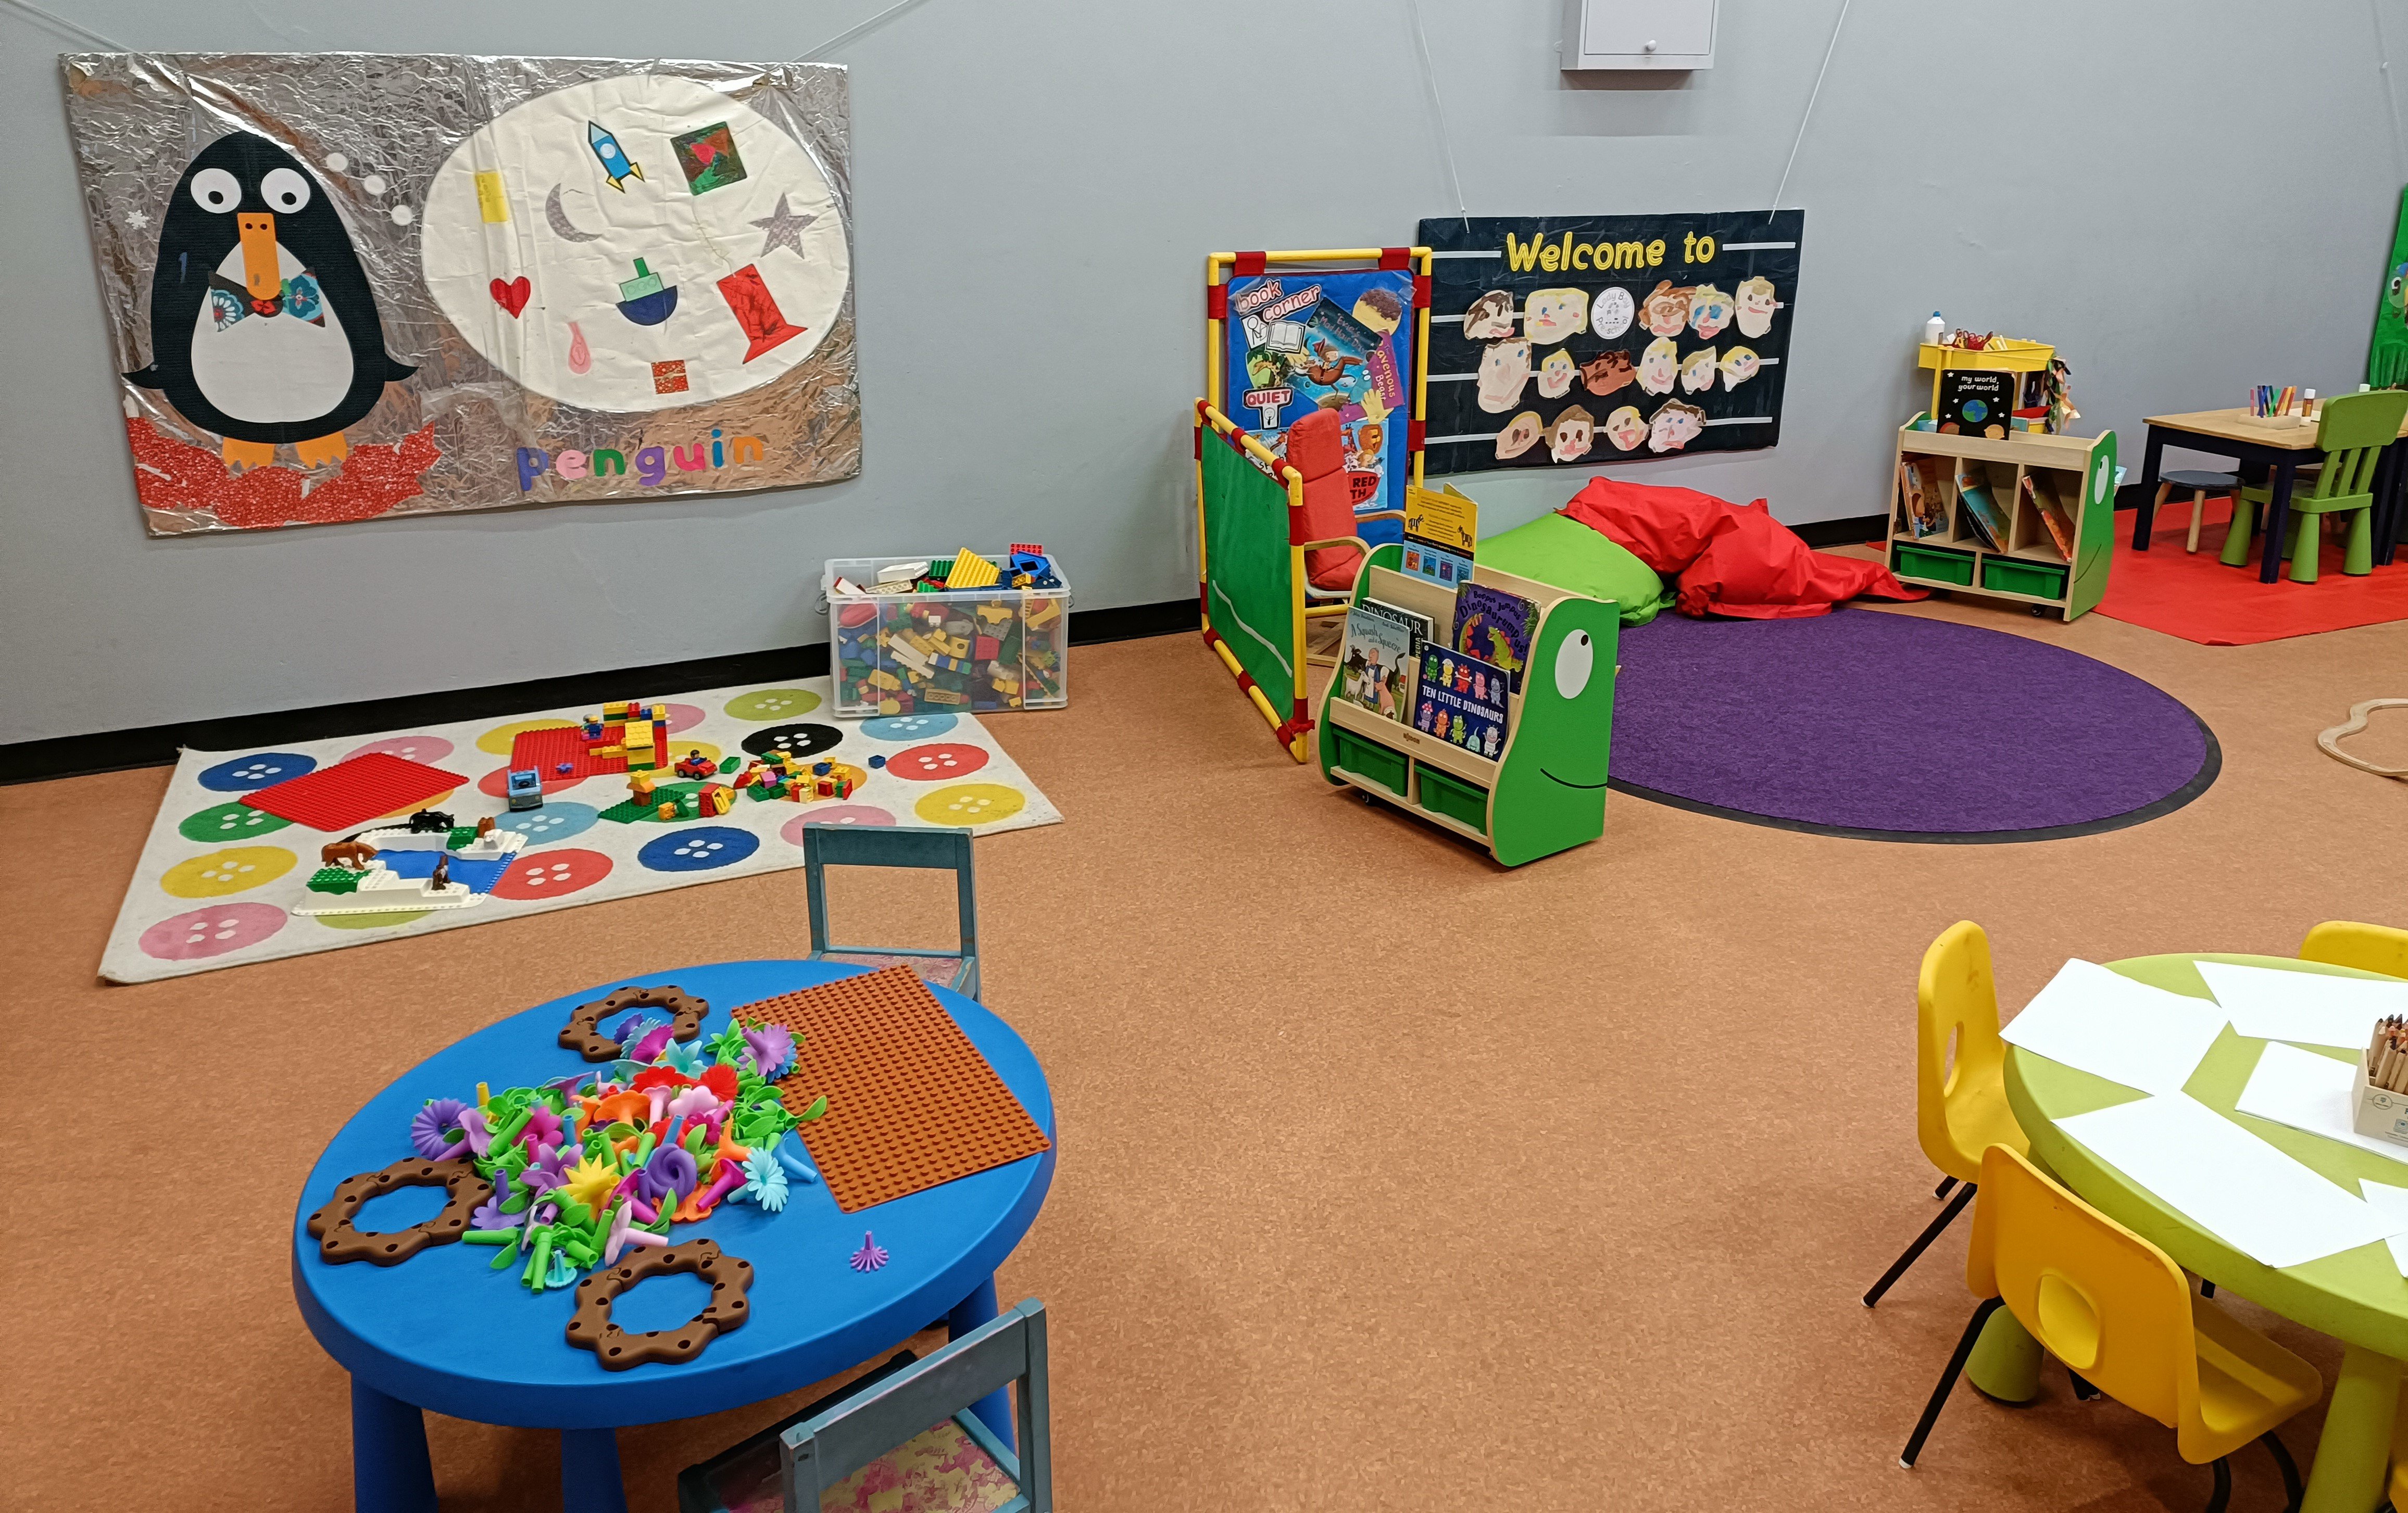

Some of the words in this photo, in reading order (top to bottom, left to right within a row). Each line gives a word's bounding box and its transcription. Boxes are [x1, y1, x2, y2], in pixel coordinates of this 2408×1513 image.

[1507, 231, 1665, 272] Welcome
[1684, 231, 1715, 263] to
[1237, 280, 1282, 311] book
[1264, 286, 1319, 321] corner
[1597, 292, 1616, 308] Lady
[1618, 292, 1631, 309] Bay
[1319, 316, 1336, 331] Mad
[1377, 340, 1396, 398] avenous
[1974, 376, 1999, 384] world,
[1247, 390, 1290, 405] QUIET
[1375, 374, 1386, 400] Beast
[516, 428, 764, 491] penguin
[1352, 476, 1377, 488] RED
[1357, 623, 1378, 640] Squash
[1422, 685, 1437, 699] TEN
[1438, 690, 1462, 709] LITTLE
[1463, 700, 1503, 724] DINOSAURS
